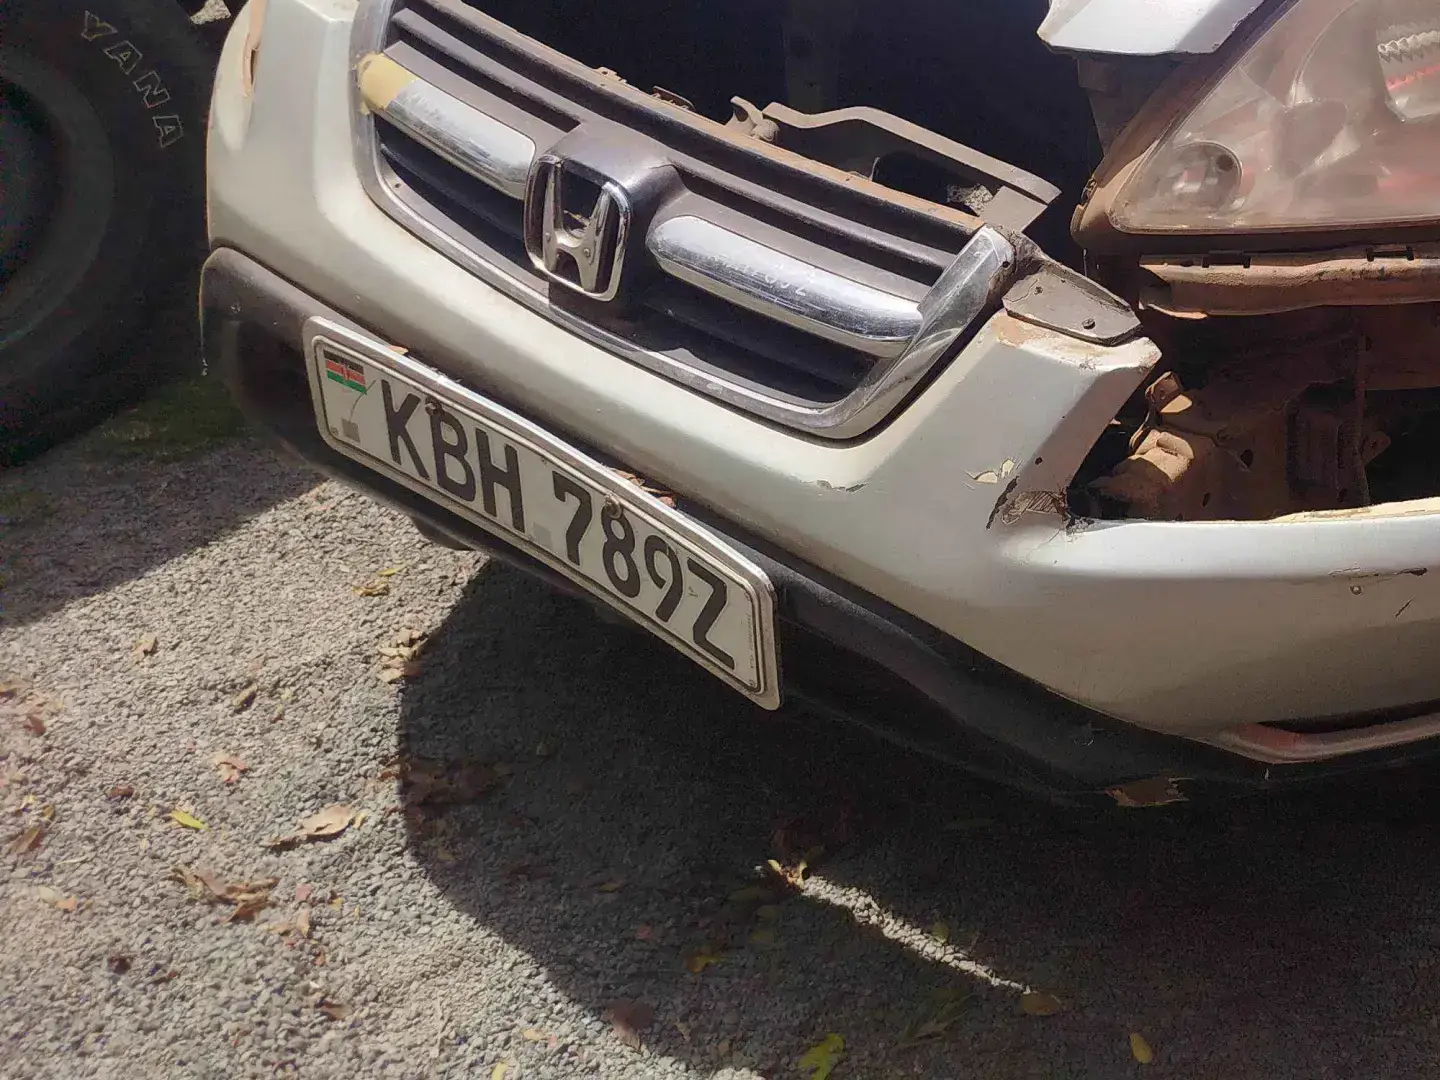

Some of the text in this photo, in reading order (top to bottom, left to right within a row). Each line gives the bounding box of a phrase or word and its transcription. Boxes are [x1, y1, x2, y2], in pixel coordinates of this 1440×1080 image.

[81, 10, 185, 148] YANA
[381, 379, 736, 671] KBH 789Z
